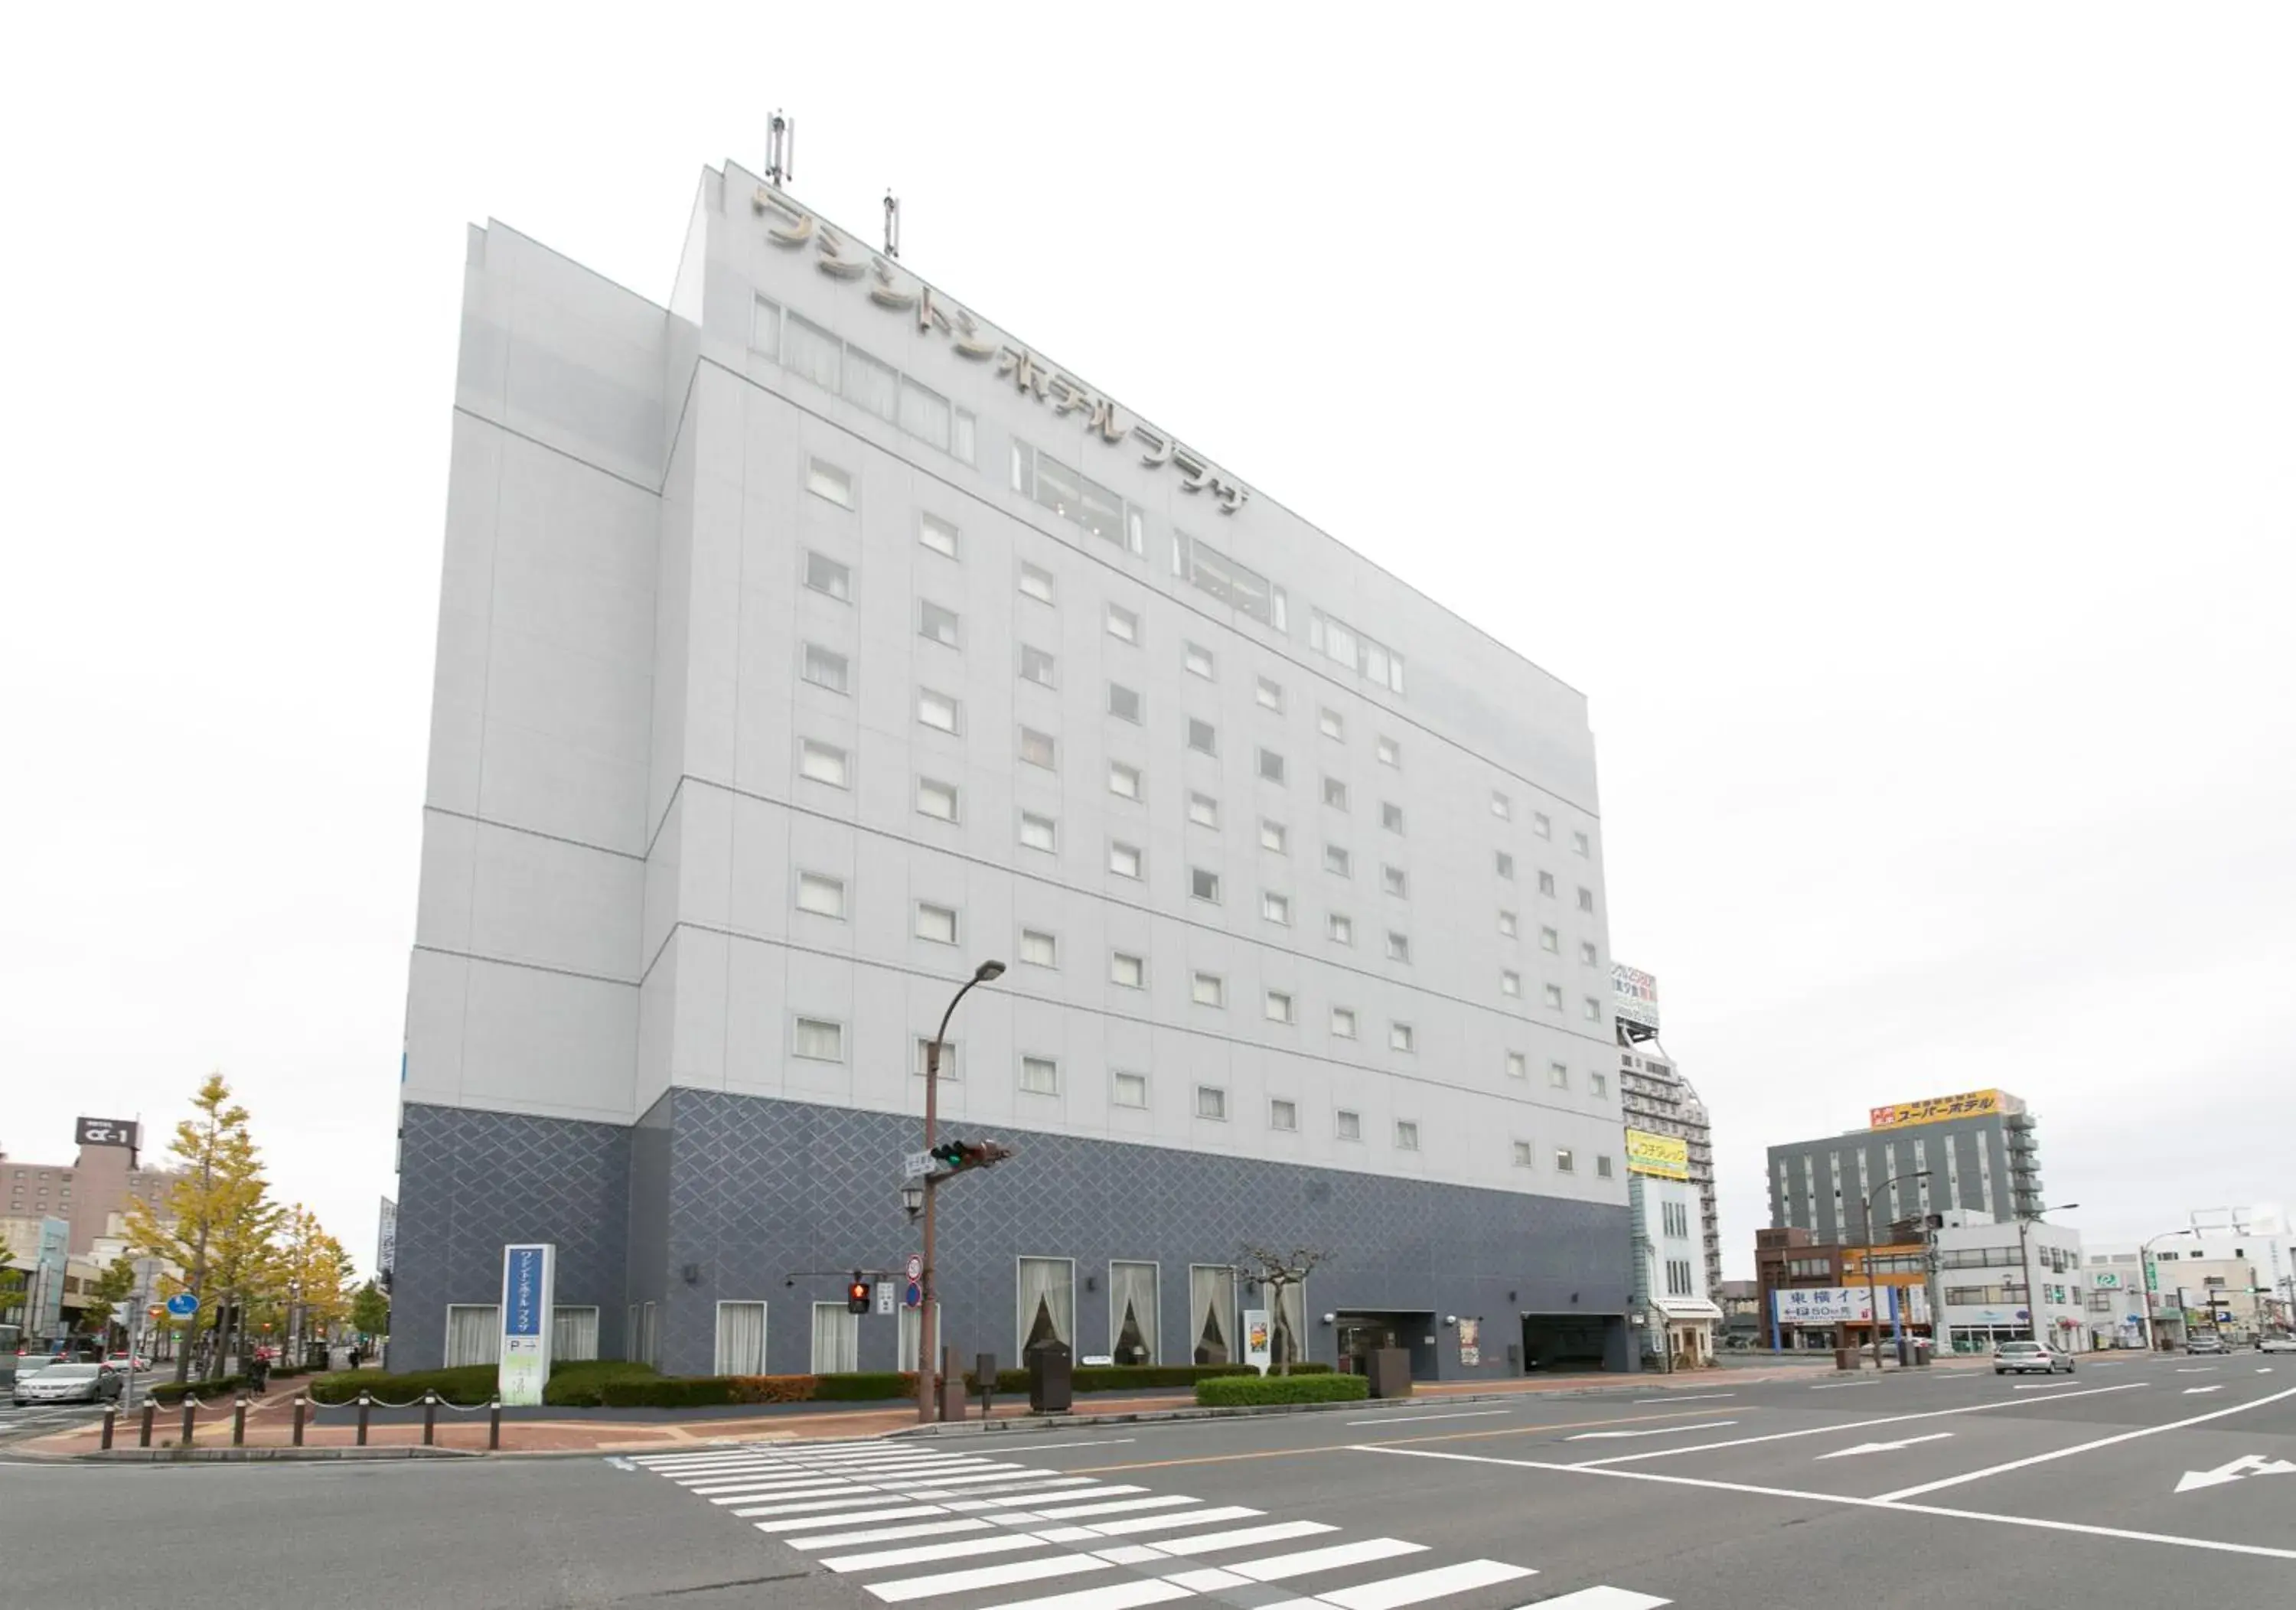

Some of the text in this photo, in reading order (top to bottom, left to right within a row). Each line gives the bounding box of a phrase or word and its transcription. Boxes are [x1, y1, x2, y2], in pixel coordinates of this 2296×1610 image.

[1897, 1097, 1994, 1122] スーパーホテル
[1791, 1289, 1874, 1305] 東横イン
[510, 1340, 520, 1351] P
